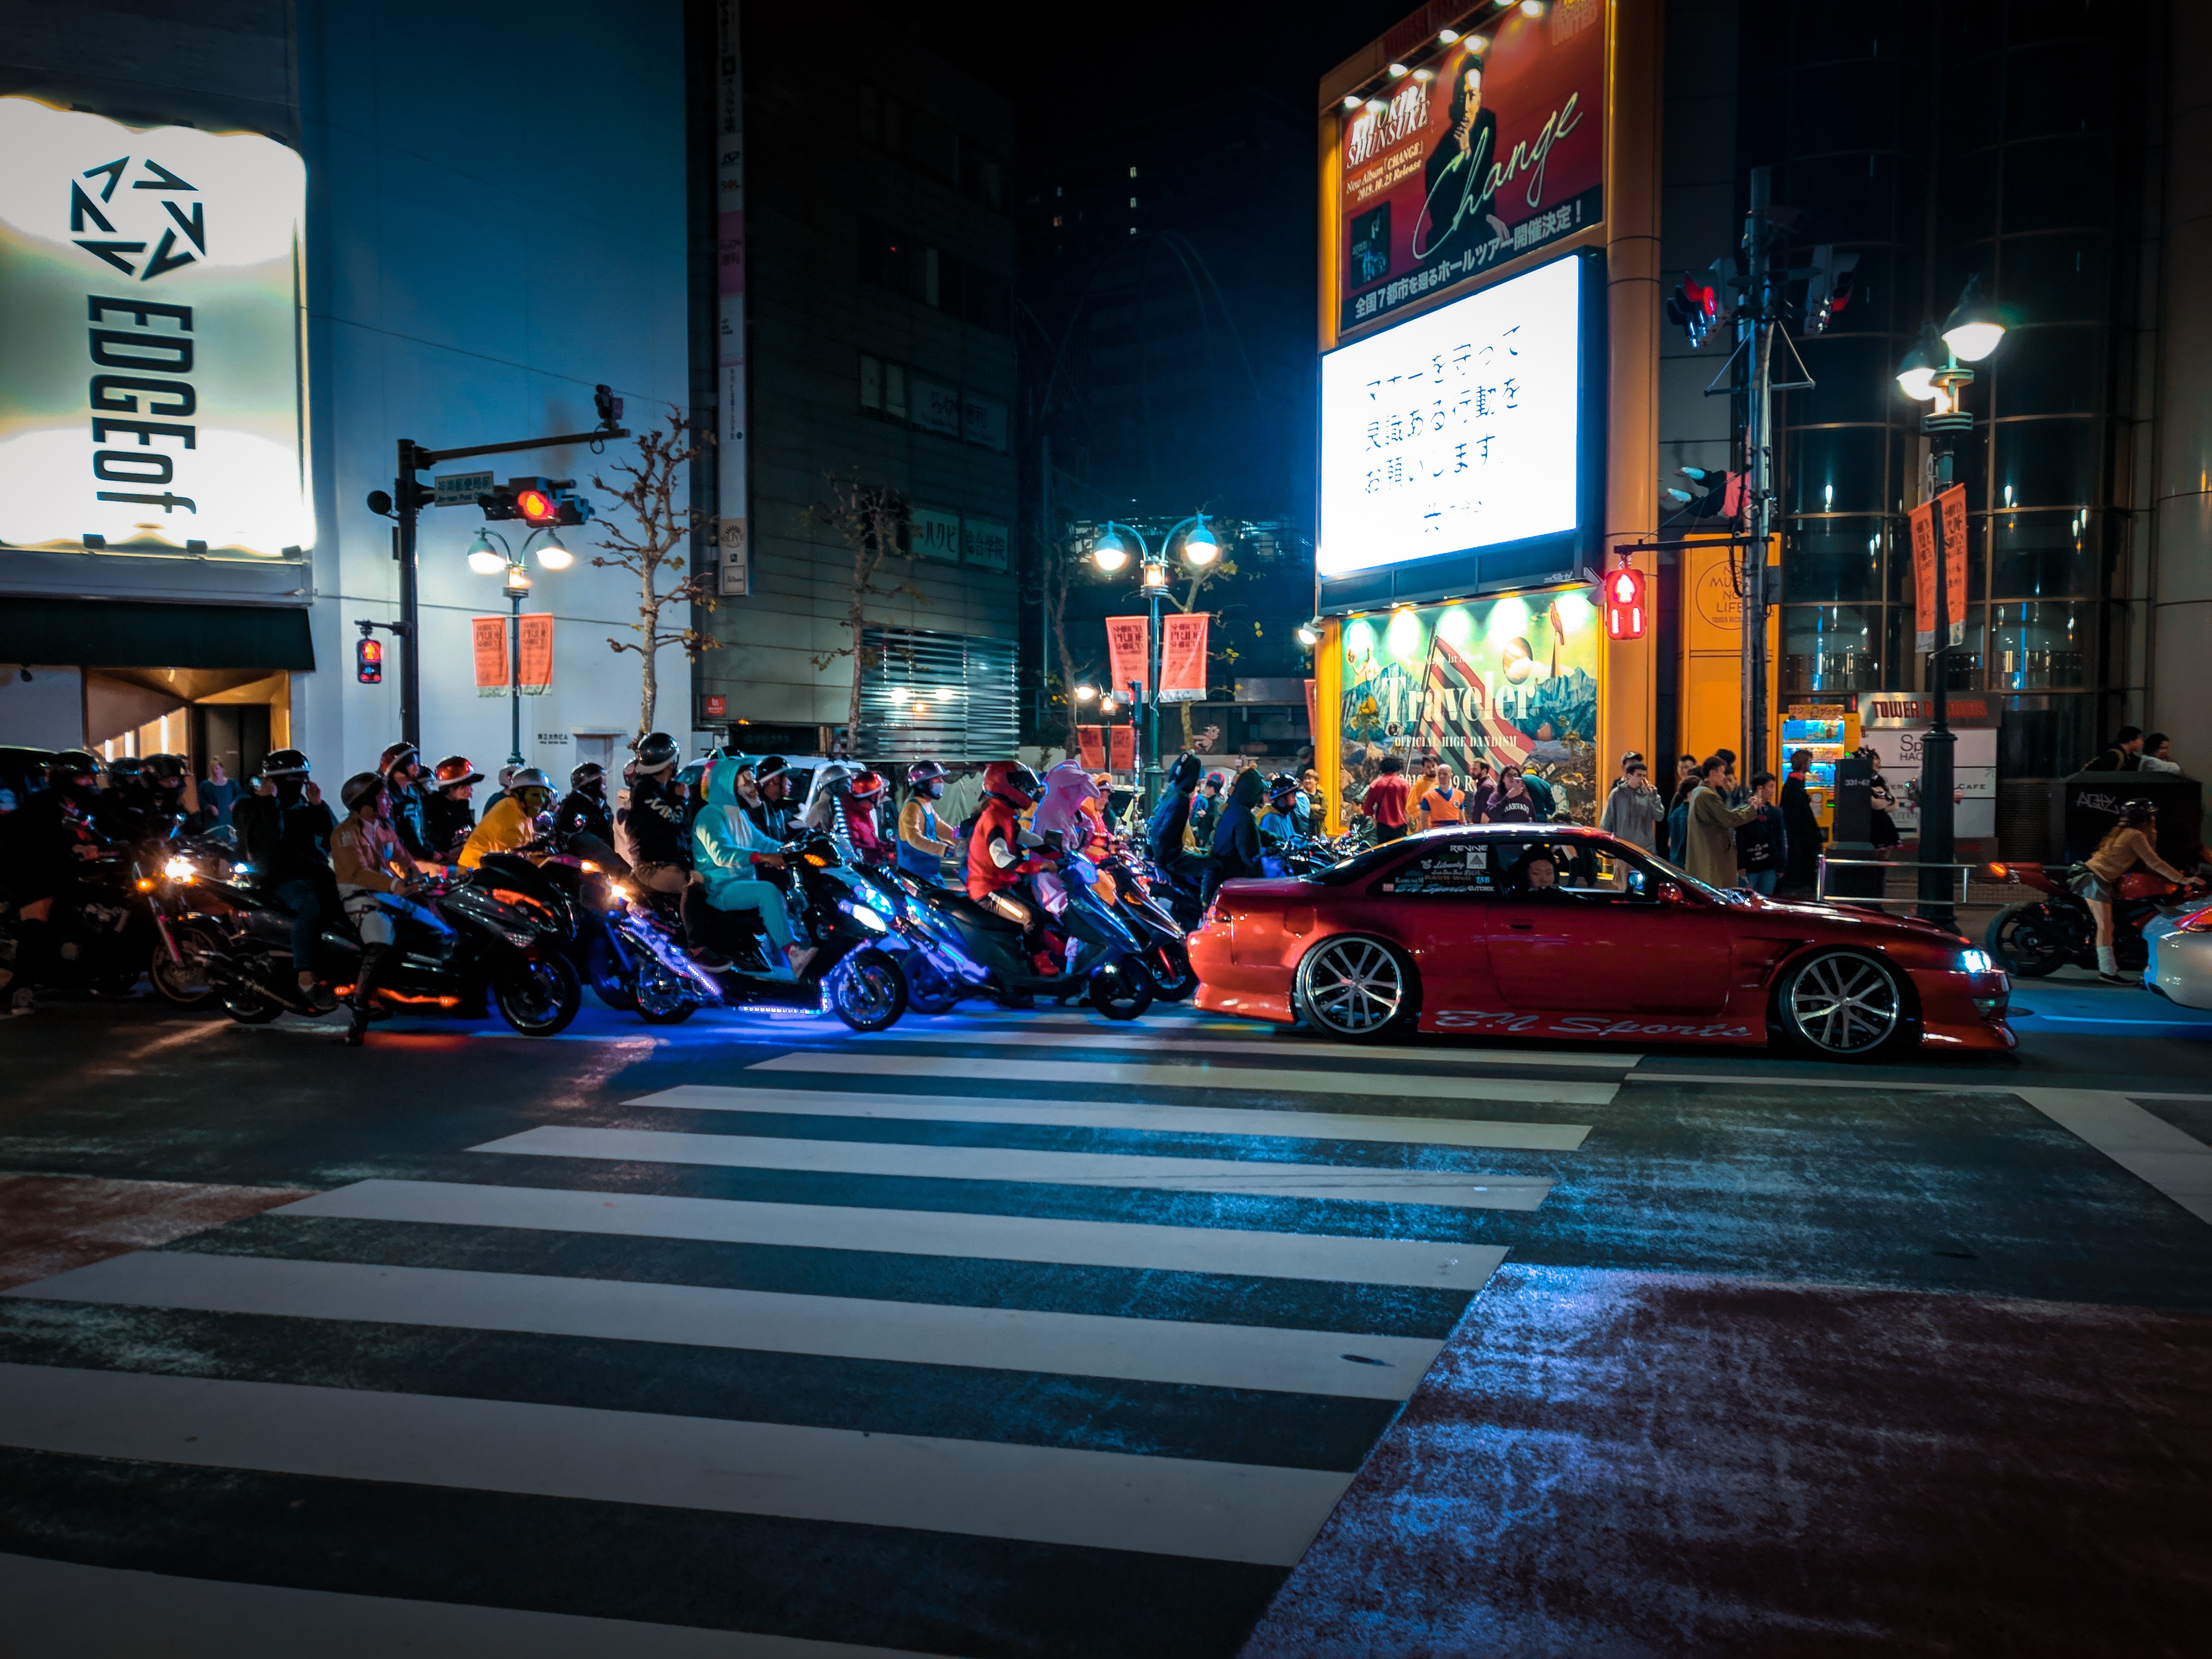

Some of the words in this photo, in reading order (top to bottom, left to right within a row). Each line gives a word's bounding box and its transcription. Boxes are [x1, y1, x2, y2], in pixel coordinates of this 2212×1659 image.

[1346, 100, 1430, 170] SHUNSUKE
[1346, 182, 1361, 195] New
[1362, 166, 1383, 185] Album
[1393, 159, 1422, 181] Release
[1412, 92, 1583, 260] Change
[87, 294, 197, 515] EDGEof
[1716, 602, 1742, 613] LIFE
[1448, 653, 1459, 664] 1st
[1381, 671, 1535, 722] Traveler
[1872, 701, 1920, 718] TOWER
[1394, 736, 1438, 748] OFFICIAL
[1442, 735, 1467, 747] HIGE
[1469, 735, 1518, 748] DANDISM
[1504, 802, 1530, 815] HARVARD
[1549, 1017, 1753, 1037] Sports
